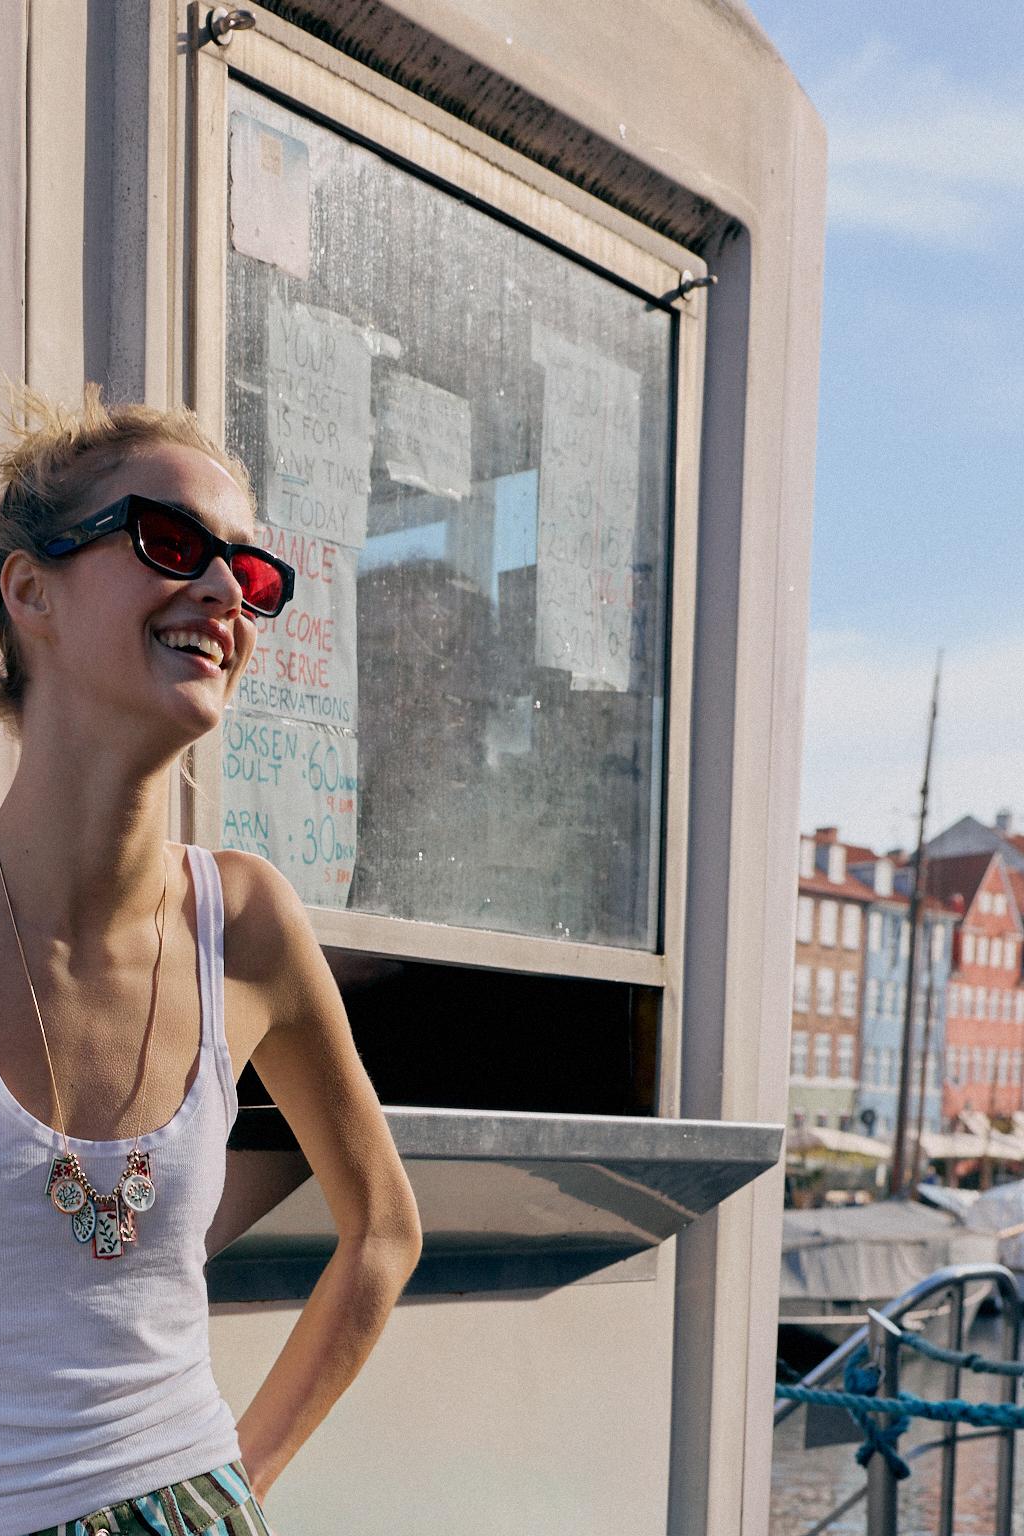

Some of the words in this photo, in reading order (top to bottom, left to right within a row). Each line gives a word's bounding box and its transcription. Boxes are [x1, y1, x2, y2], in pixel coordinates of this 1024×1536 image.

[302, 415, 341, 452] FOR
[322, 458, 366, 496] TIME
[282, 489, 350, 540] TODAY
[254, 525, 337, 585] RANCE
[286, 607, 335, 652] COME
[275, 649, 330, 689] SERVE
[239, 676, 352, 720] RESERVATIONS
[223, 753, 283, 785] DULT
